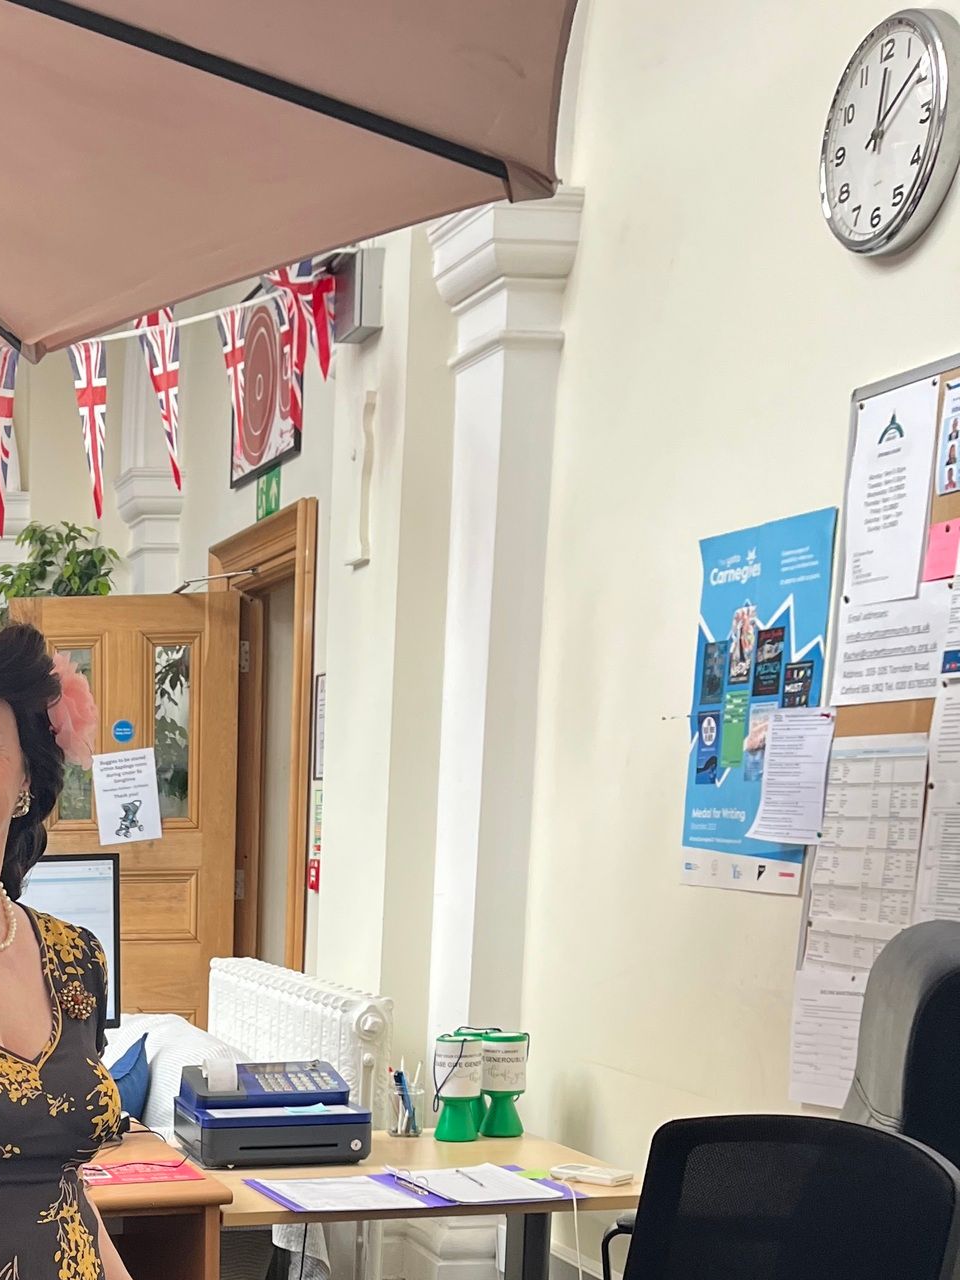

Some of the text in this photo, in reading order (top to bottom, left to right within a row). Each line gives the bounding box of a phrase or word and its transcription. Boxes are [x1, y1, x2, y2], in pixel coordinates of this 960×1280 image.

[881, 38, 895, 64] 12
[907, 37, 912, 58] 1
[860, 65, 869, 89] 11
[843, 103, 855, 126] 10
[919, 100, 932, 124] 3
[835, 146, 846, 167] 9
[910, 144, 922, 166] 4
[838, 183, 850, 204] 8
[891, 184, 904, 207] 5
[852, 204, 862, 227] 7
[870, 206, 881, 228] 6
[692, 808, 746, 822] Medal for Writing
